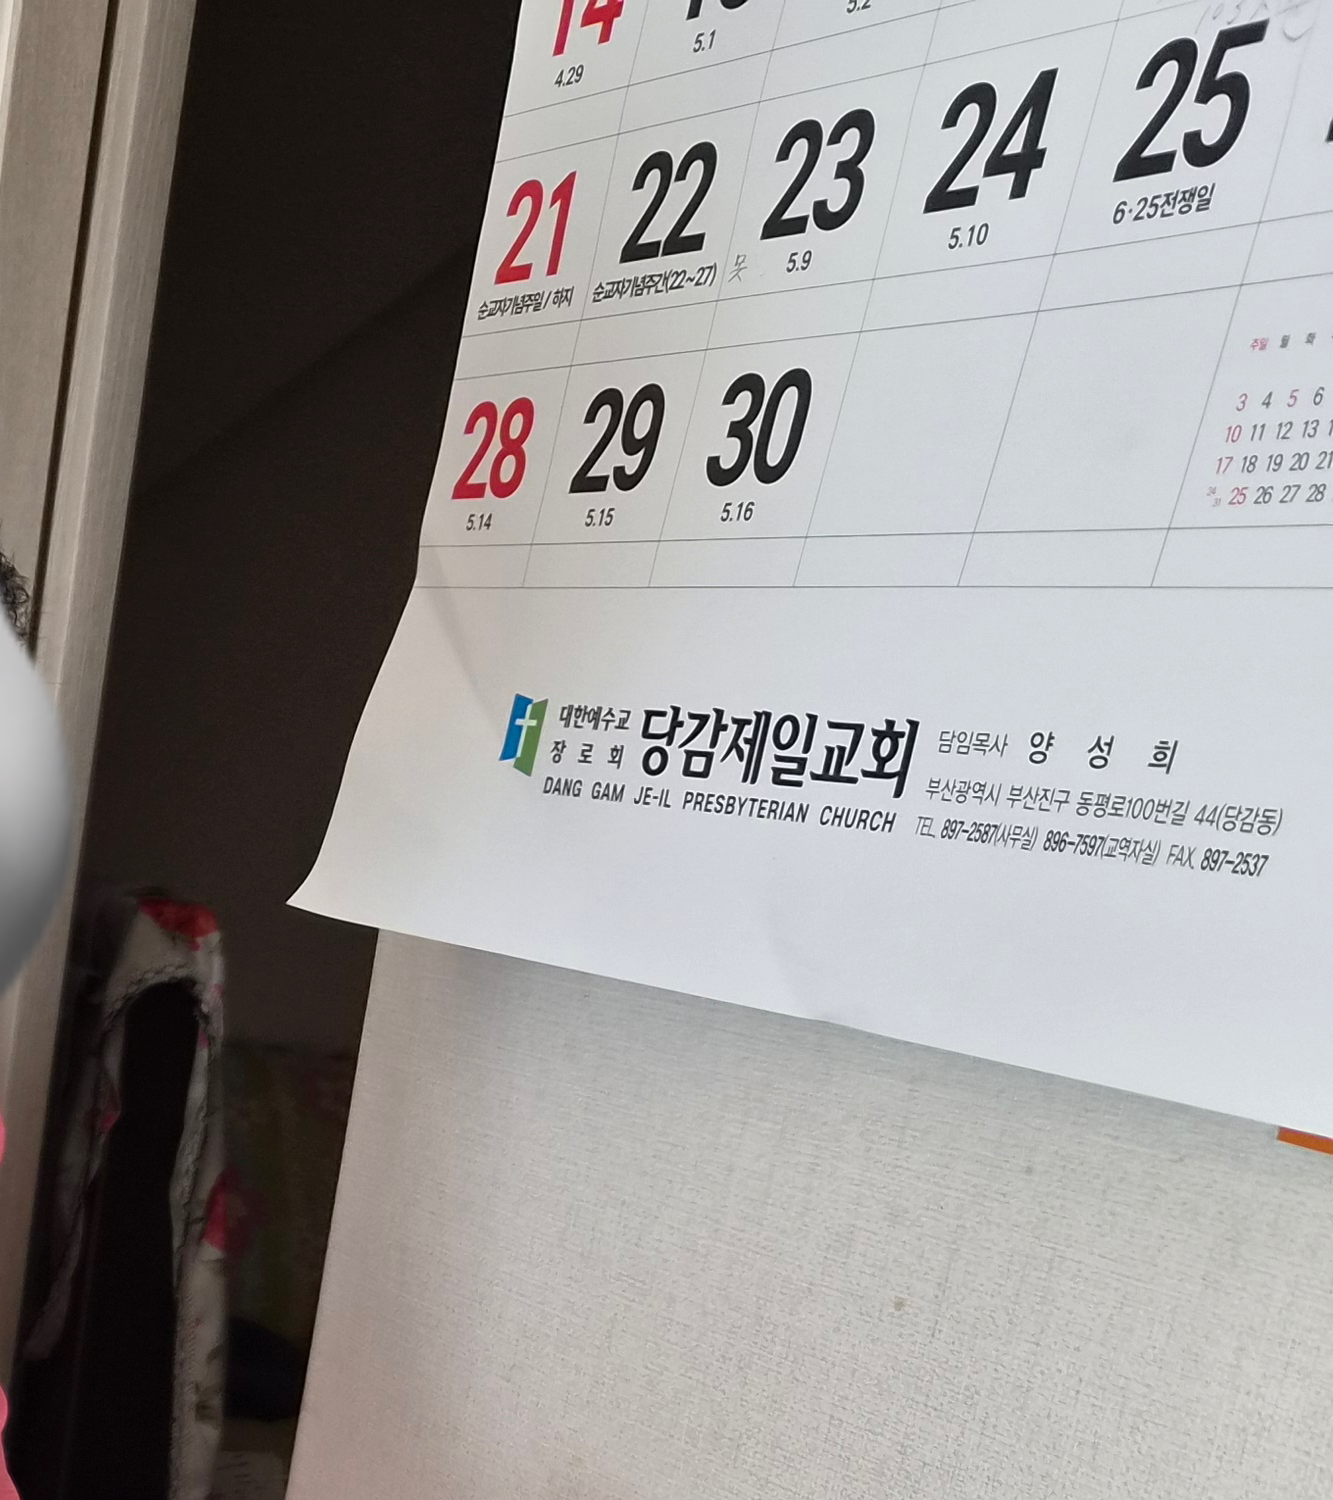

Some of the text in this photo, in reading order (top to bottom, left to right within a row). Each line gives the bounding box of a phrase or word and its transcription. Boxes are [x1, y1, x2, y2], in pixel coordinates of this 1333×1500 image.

[554, 64, 584, 88] 4.29
[693, 29, 717, 53] 5.1
[494, 18, 1270, 285] 21 22 23 24 25
[947, 222, 990, 251] 5.10
[786, 249, 813, 275] 5.9
[552, 286, 575, 307] 하지
[1236, 387, 1325, 411] 3 4 5 6
[451, 367, 813, 500] 28 29 30
[1225, 419, 1321, 443] 10 11 12 13
[1216, 456, 1234, 475] 17
[1241, 455, 1258, 474] 18
[1266, 454, 1284, 472] 19
[1289, 452, 1310, 472] 20
[1228, 486, 1249, 505] 25
[1253, 485, 1274, 505] 26
[1279, 484, 1301, 504] 27
[1305, 483, 1327, 503] 28
[466, 501, 755, 531] 5.14 5.15 5.16
[559, 704, 632, 731] 대한예수교
[549, 739, 625, 770] 장 로 회
[639, 703, 921, 799] 당감제일교회
[938, 728, 1178, 774] 담임목사 양 성 희
[541, 776, 897, 833] DANG GAM JE-IL PRESBYTERIAN CHURCH
[925, 777, 1283, 838] 부산광역시 부산진구 동평로100번길 44(당감동)
[940, 817, 1039, 852] 897-2587(사무실)
[1199, 847, 1270, 879] 897-2537
